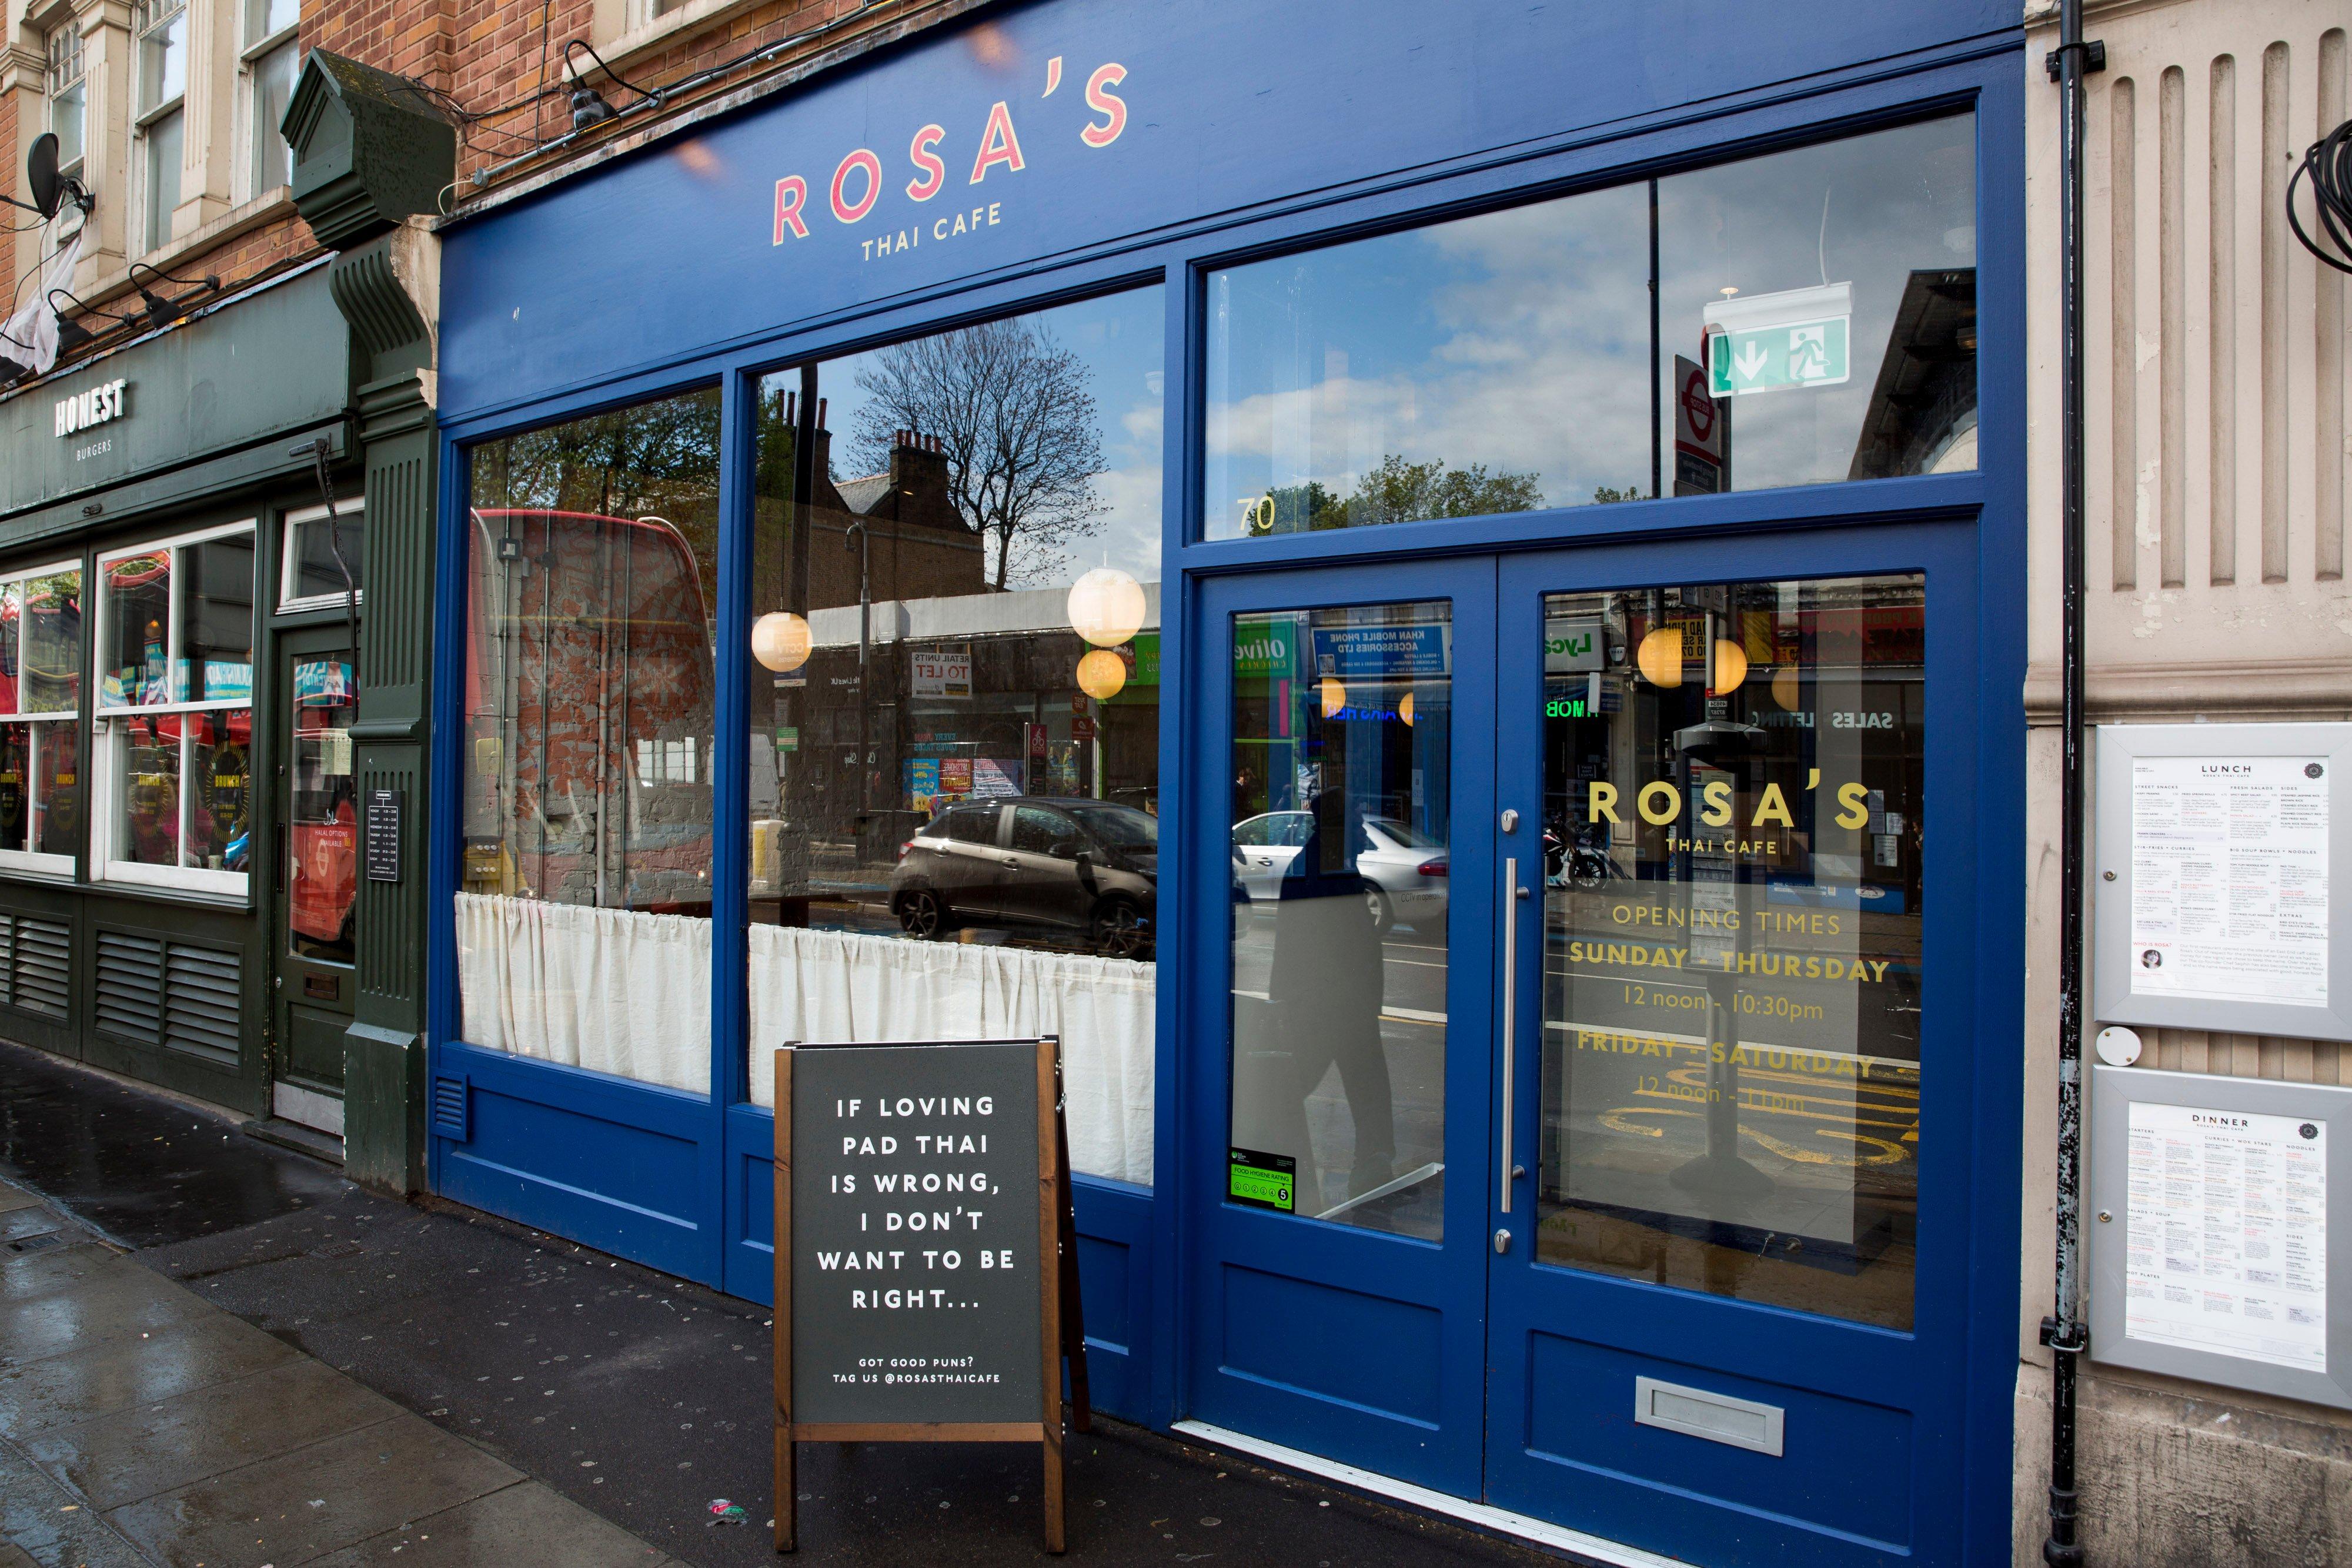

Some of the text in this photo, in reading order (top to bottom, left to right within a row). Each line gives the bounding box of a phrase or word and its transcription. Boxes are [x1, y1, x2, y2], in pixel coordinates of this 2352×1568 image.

[773, 56, 1128, 246] ROSA'S
[862, 203, 1001, 261] THAI CAFE
[56, 379, 125, 437] HONEST
[77, 440, 111, 461] BURGERS
[1237, 496, 1275, 530] 70
[215, 775, 240, 788] BRUNCH
[1589, 768, 1869, 830] ROSA'S
[1666, 838, 1776, 855] THAI CAFE
[1612, 905, 1840, 935] OPENING TIMES
[1569, 942, 1688, 969] SUNDAY
[1720, 952, 1890, 983] THURSDAY
[1624, 985, 1646, 1004] 12
[1653, 988, 1706, 1010] noon
[1732, 994, 1823, 1022] 10:30pm
[1578, 1030, 1675, 1058] FRIDAY
[1710, 1042, 1876, 1078] SATURDAY
[1638, 1075, 1658, 1093] 12
[1666, 1080, 1720, 1102] noon
[1746, 1088, 1805, 1115] 11pm
[837, 1096, 993, 1117] IF LOVING
[2192, 1115, 2248, 1126] DINNER
[843, 1135, 987, 1155] PAD THAI
[831, 1173, 998, 1195] IS WRONG,
[1280, 1189, 1286, 1199] 5
[861, 1206, 983, 1231] I DON'T
[817, 1250, 1014, 1270] WANT TO BE
[853, 1289, 978, 1309] RIGHT...
[858, 1356, 973, 1367] GOT GOOD PUNS?
[833, 1374, 1000, 1383] TAG US @ROSASTHAICAFE
